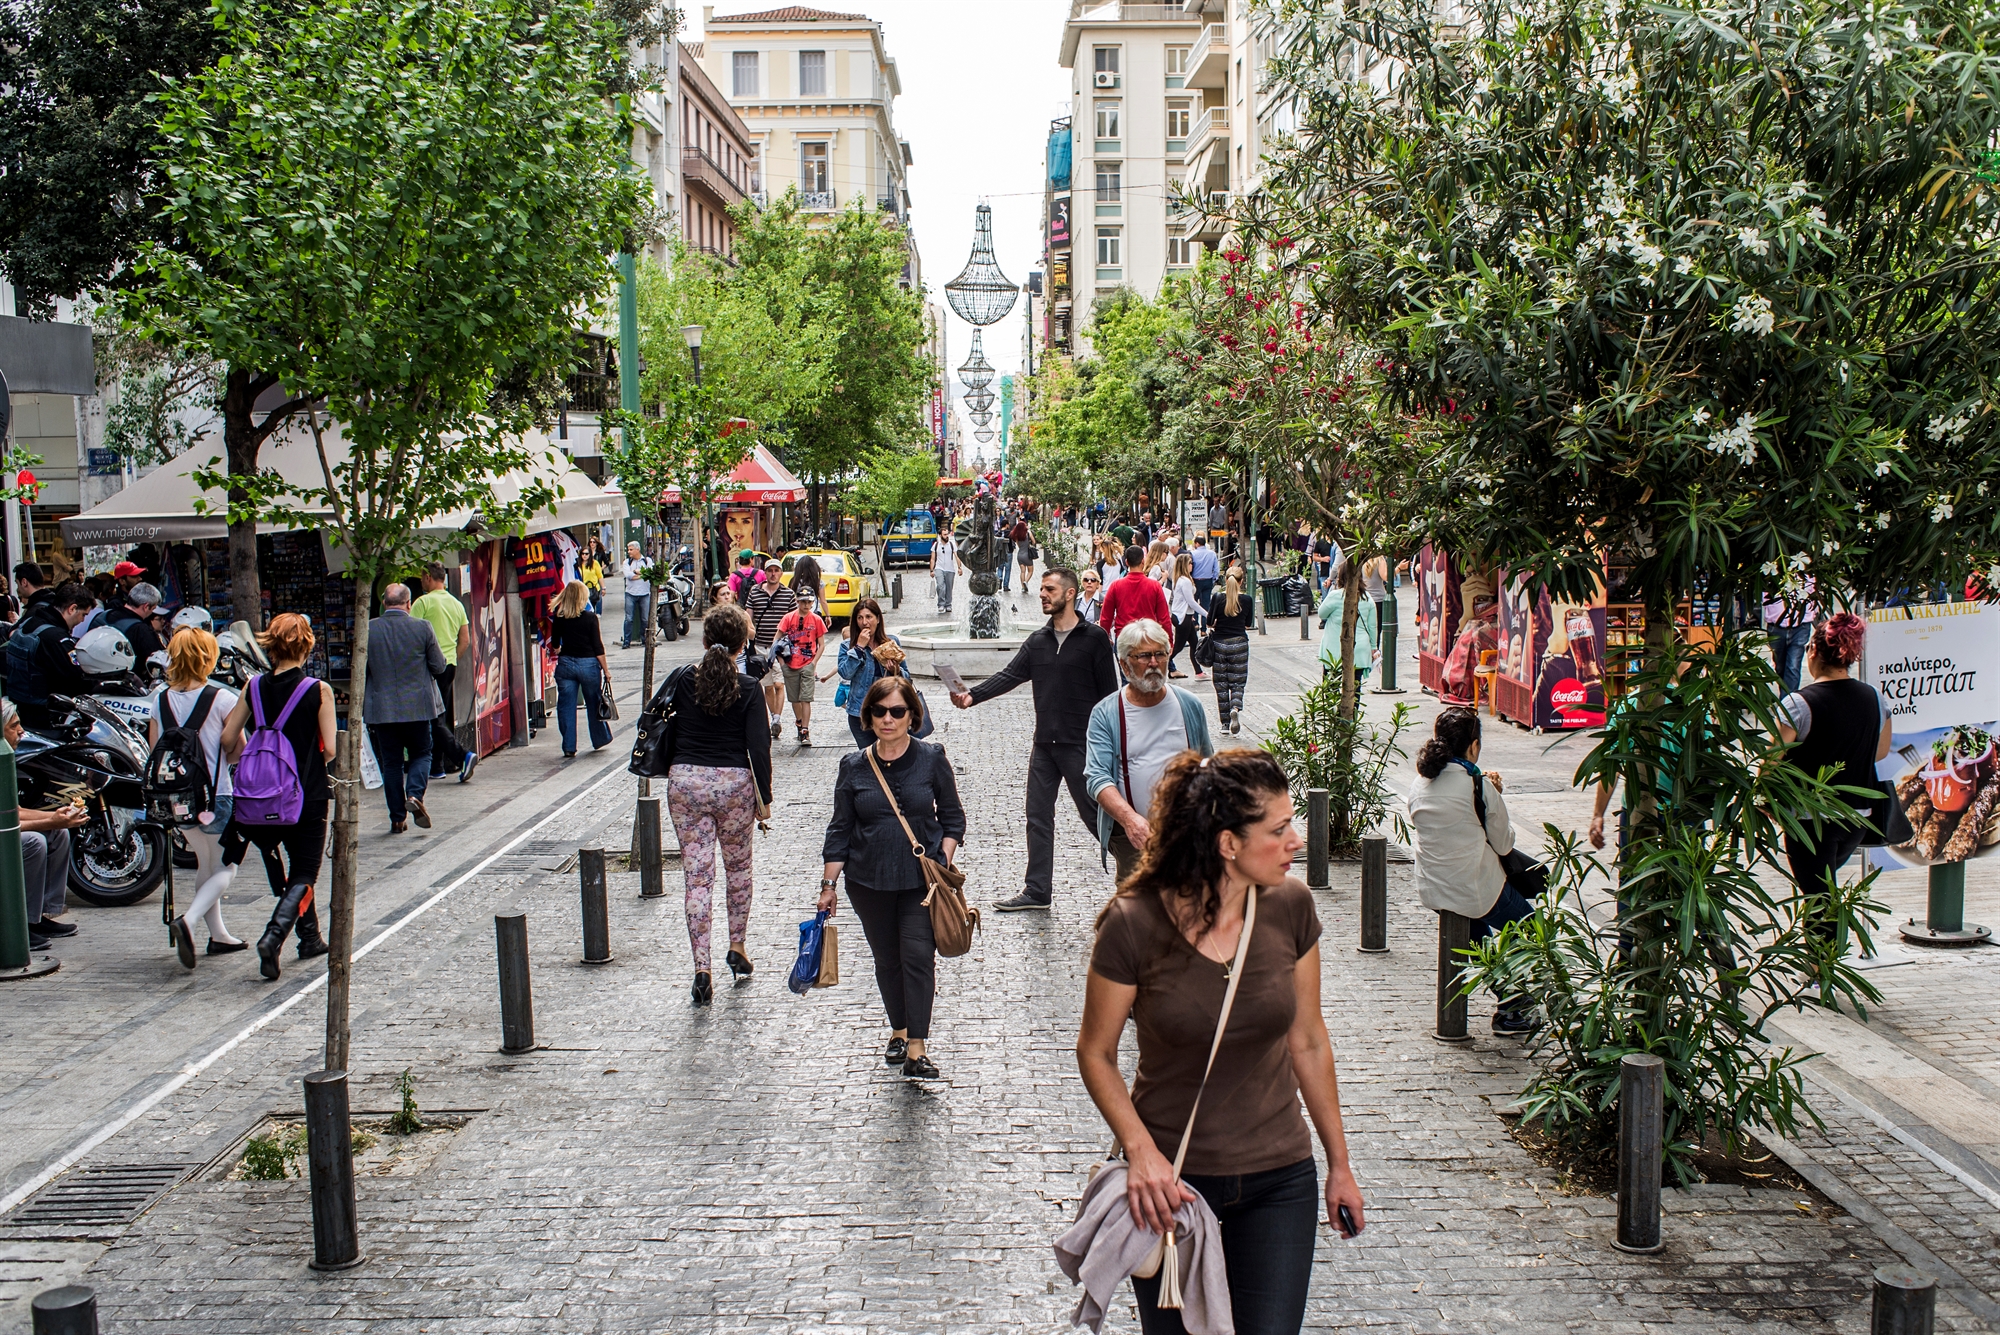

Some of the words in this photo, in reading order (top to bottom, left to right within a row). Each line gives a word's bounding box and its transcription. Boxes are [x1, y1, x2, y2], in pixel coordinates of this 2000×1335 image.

[73, 526, 162, 540] www.migato.gr
[525, 541, 544, 565] 10
[1552, 690, 1585, 702] Coca-Cola
[103, 700, 151, 715] POLICE
[1892, 703, 1917, 715] όλης
